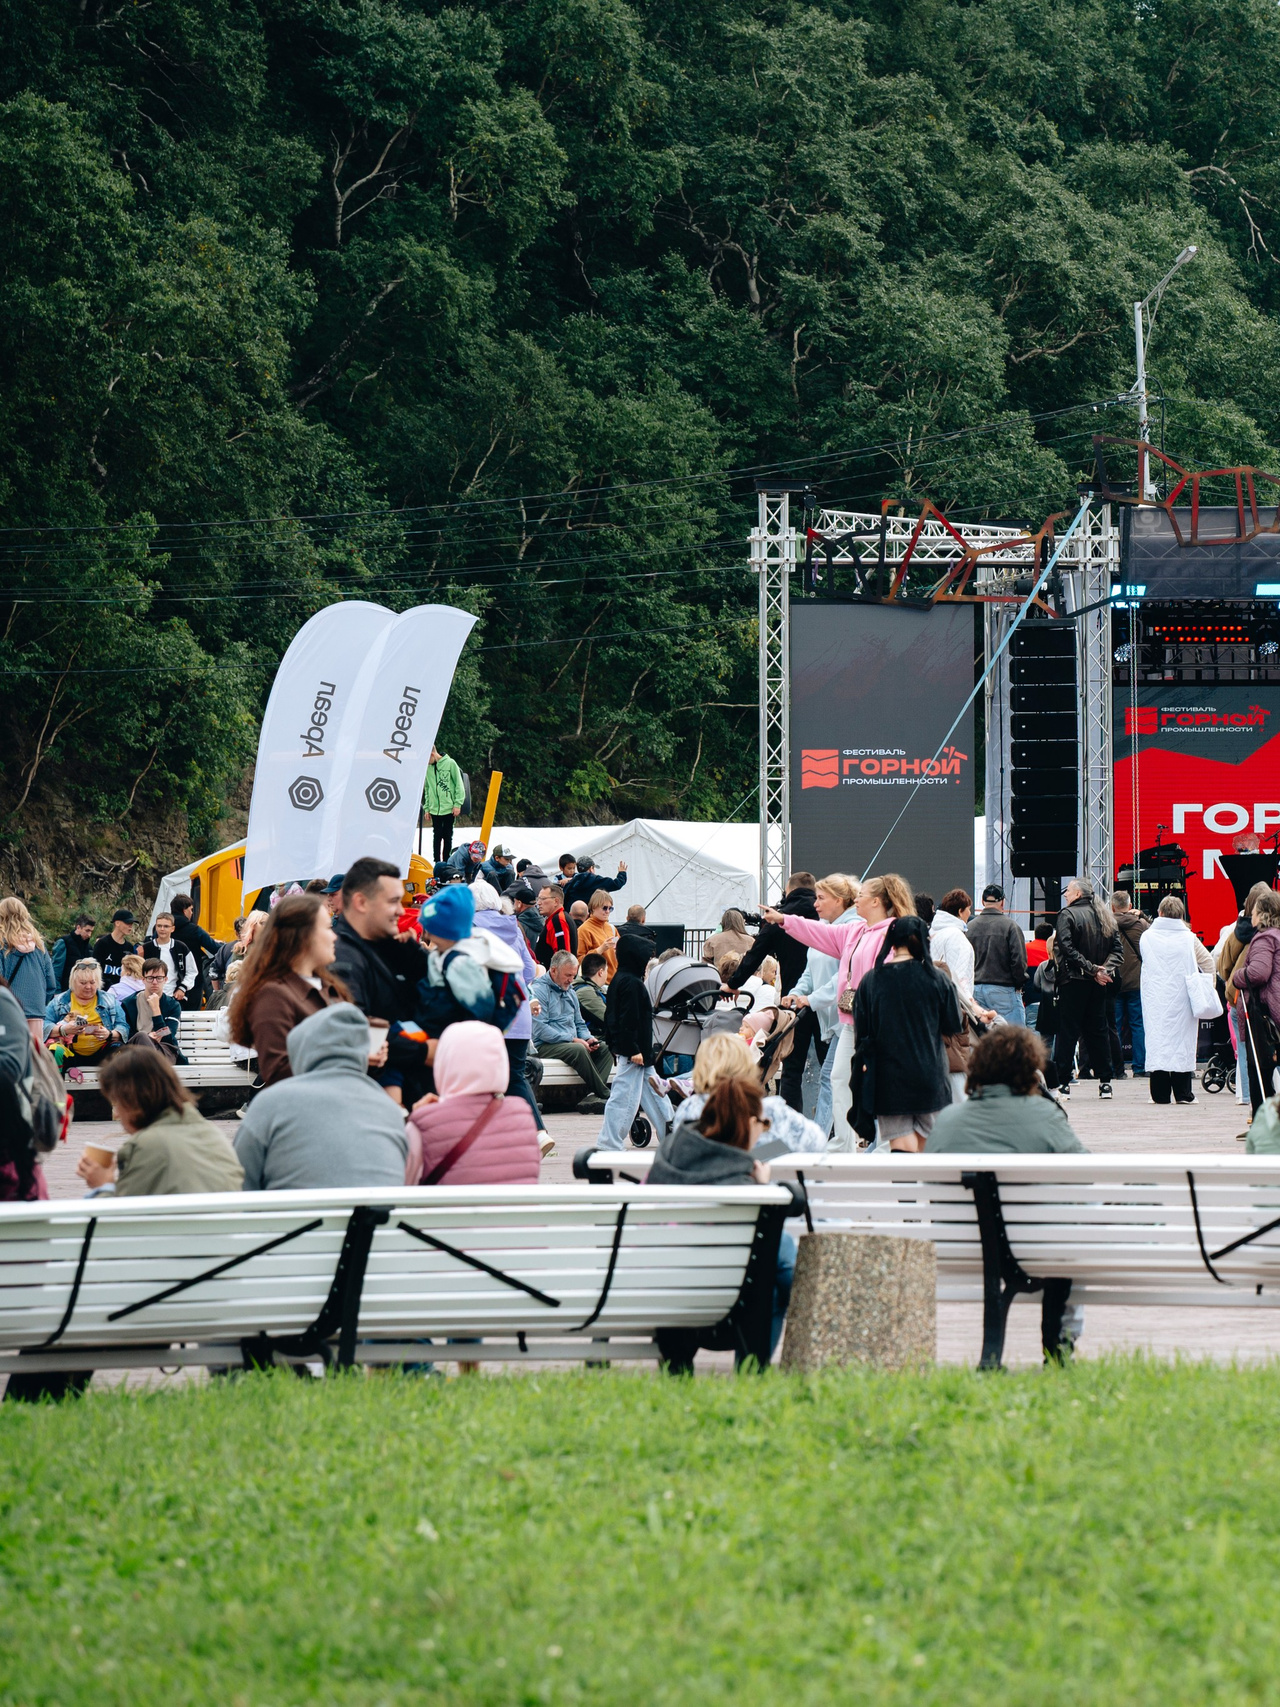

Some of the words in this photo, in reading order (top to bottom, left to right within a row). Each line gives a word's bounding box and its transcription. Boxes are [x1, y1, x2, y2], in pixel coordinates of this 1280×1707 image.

[383, 685, 421, 764] Ареал
[1160, 705, 1265, 726] ГОРНОЙ
[842, 748, 906, 756] ФЕСТИВАЛЬ
[842, 748, 961, 776] ГОРНОЙ
[842, 777, 948, 785] ПРОМЫШЛЕННОСТИ
